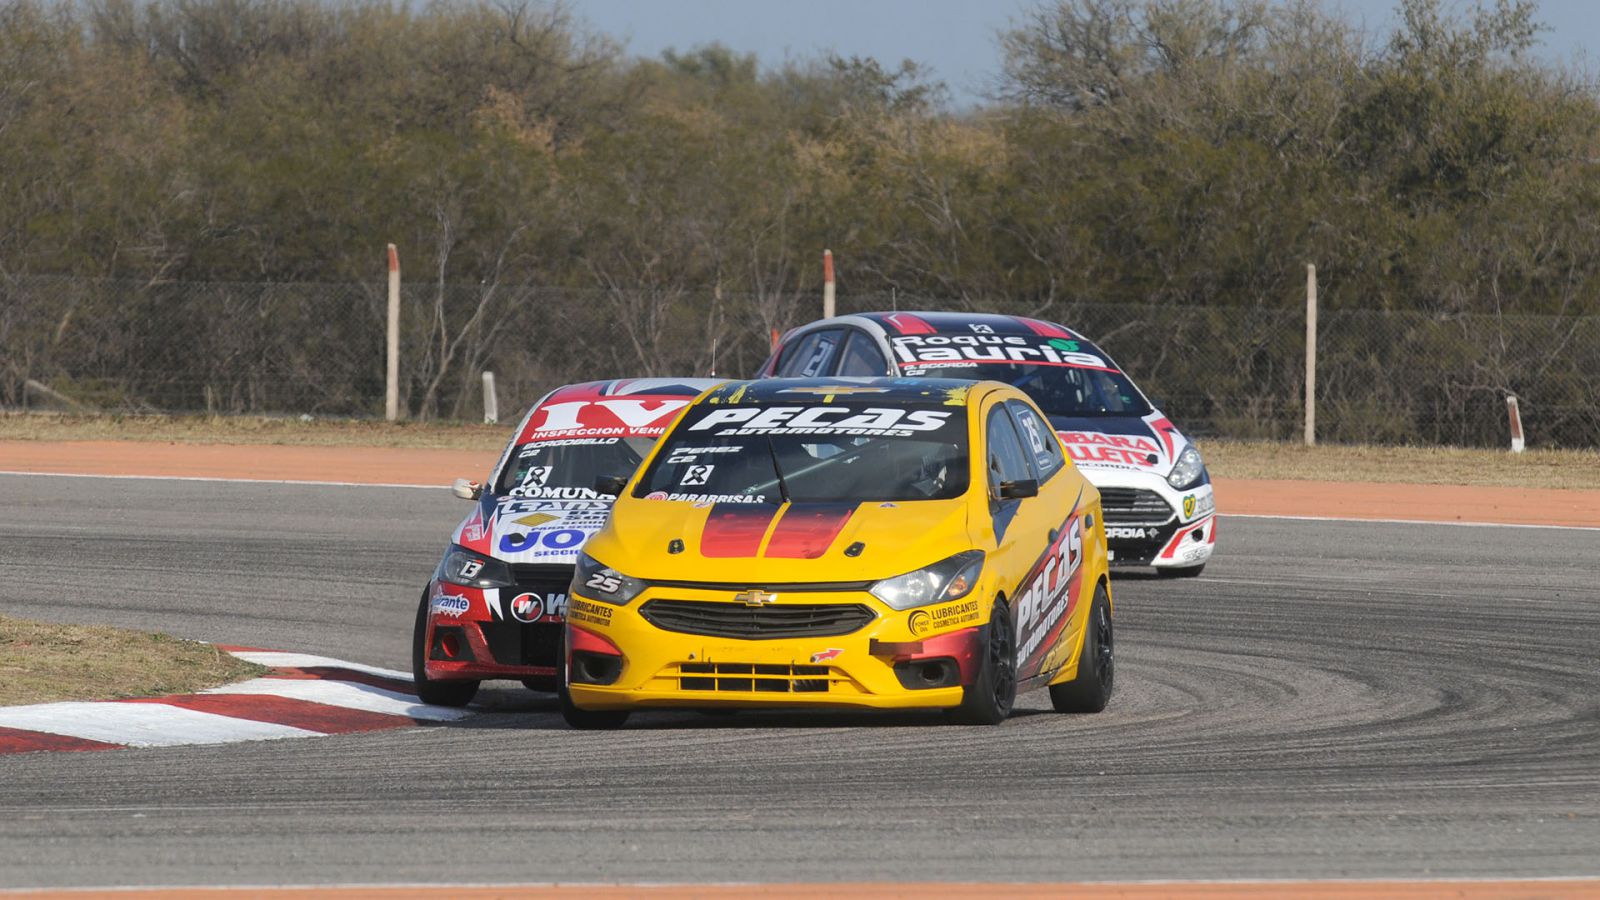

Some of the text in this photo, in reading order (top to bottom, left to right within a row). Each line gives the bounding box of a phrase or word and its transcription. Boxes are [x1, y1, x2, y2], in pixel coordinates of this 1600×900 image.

[892, 336, 1027, 346] Roque
[532, 427, 624, 439] INSPECCION
[714, 427, 914, 437] AUTOMOTORES
[671, 446, 744, 455] PEREZ
[667, 455, 697, 464] C2
[667, 493, 766, 503] PARABRISAS
[499, 530, 598, 553] JO
[585, 573, 622, 594] 25
[931, 600, 978, 620] LUBRICANTES
[933, 617, 960, 629] COSMETICA
